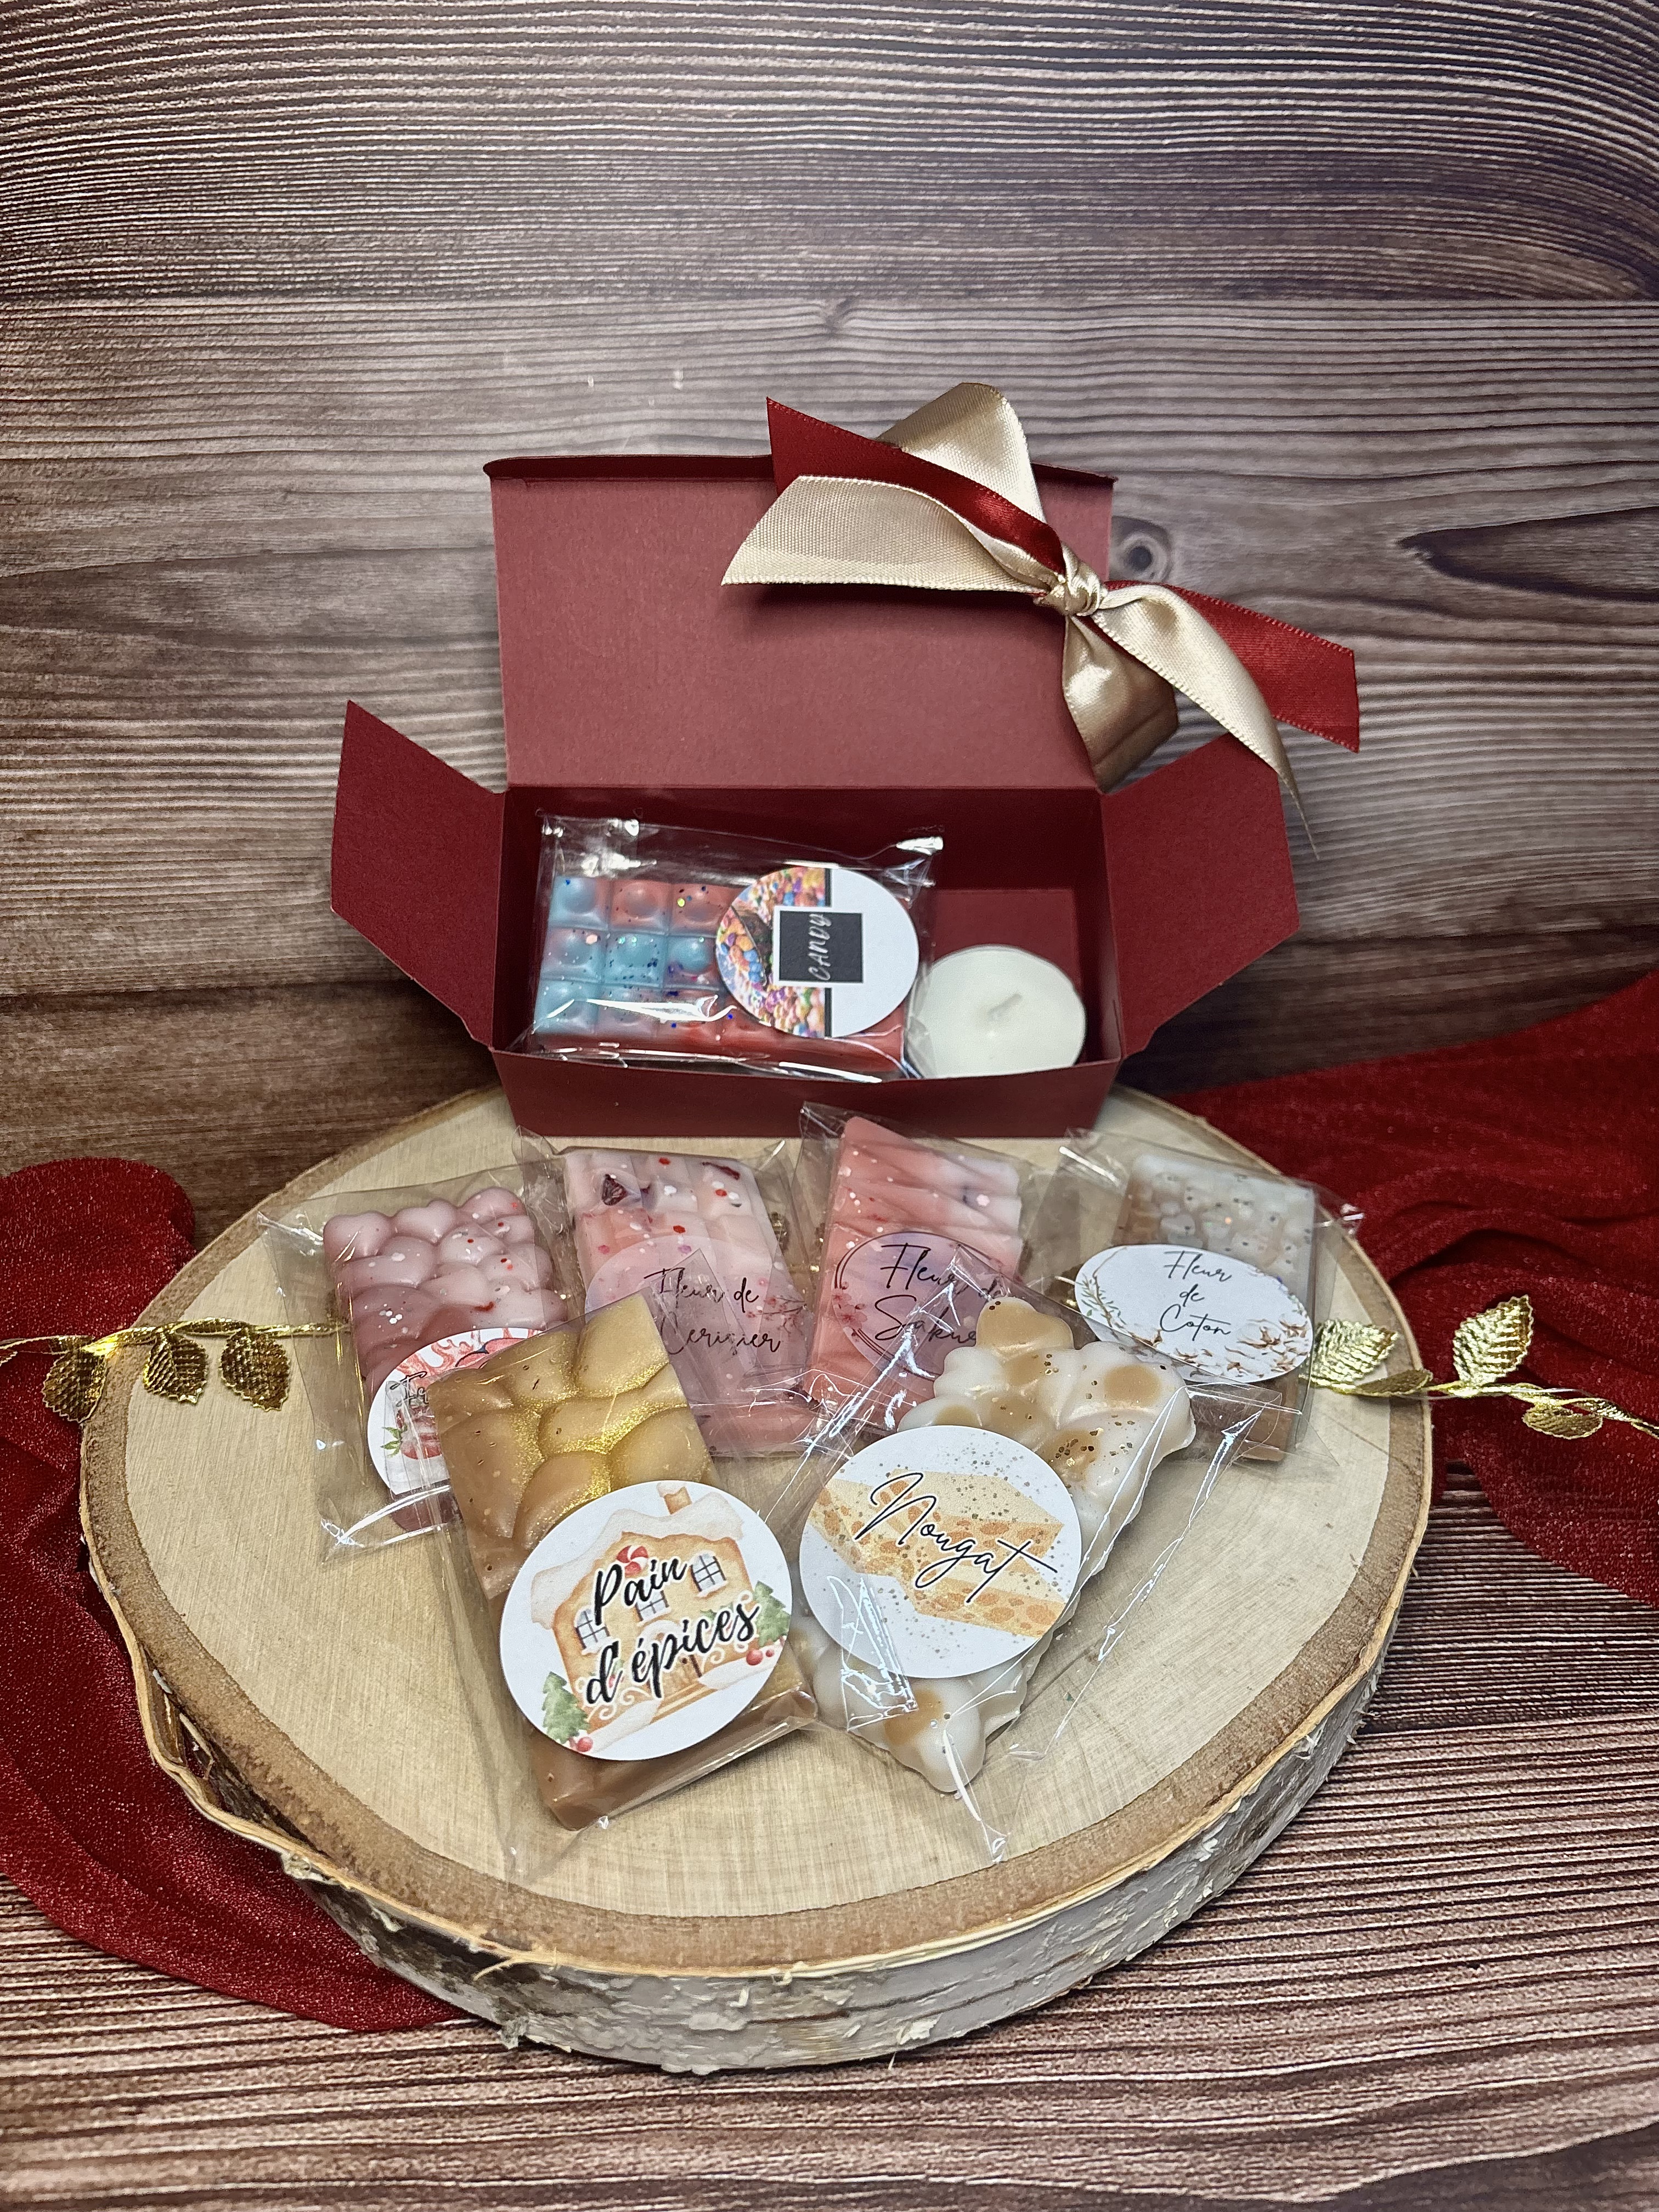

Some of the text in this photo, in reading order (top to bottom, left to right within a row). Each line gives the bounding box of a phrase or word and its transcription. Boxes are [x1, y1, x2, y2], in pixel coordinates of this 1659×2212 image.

[808, 913, 832, 981] CANDY
[643, 1267, 760, 1313] Fleur de
[879, 1242, 969, 1295] Fleur
[1163, 1250, 1233, 1282] Fleur
[1179, 1283, 1205, 1307] de
[1160, 1304, 1232, 1342] Coton
[854, 1471, 1058, 1603] Nougat
[592, 1556, 688, 1626] Pain
